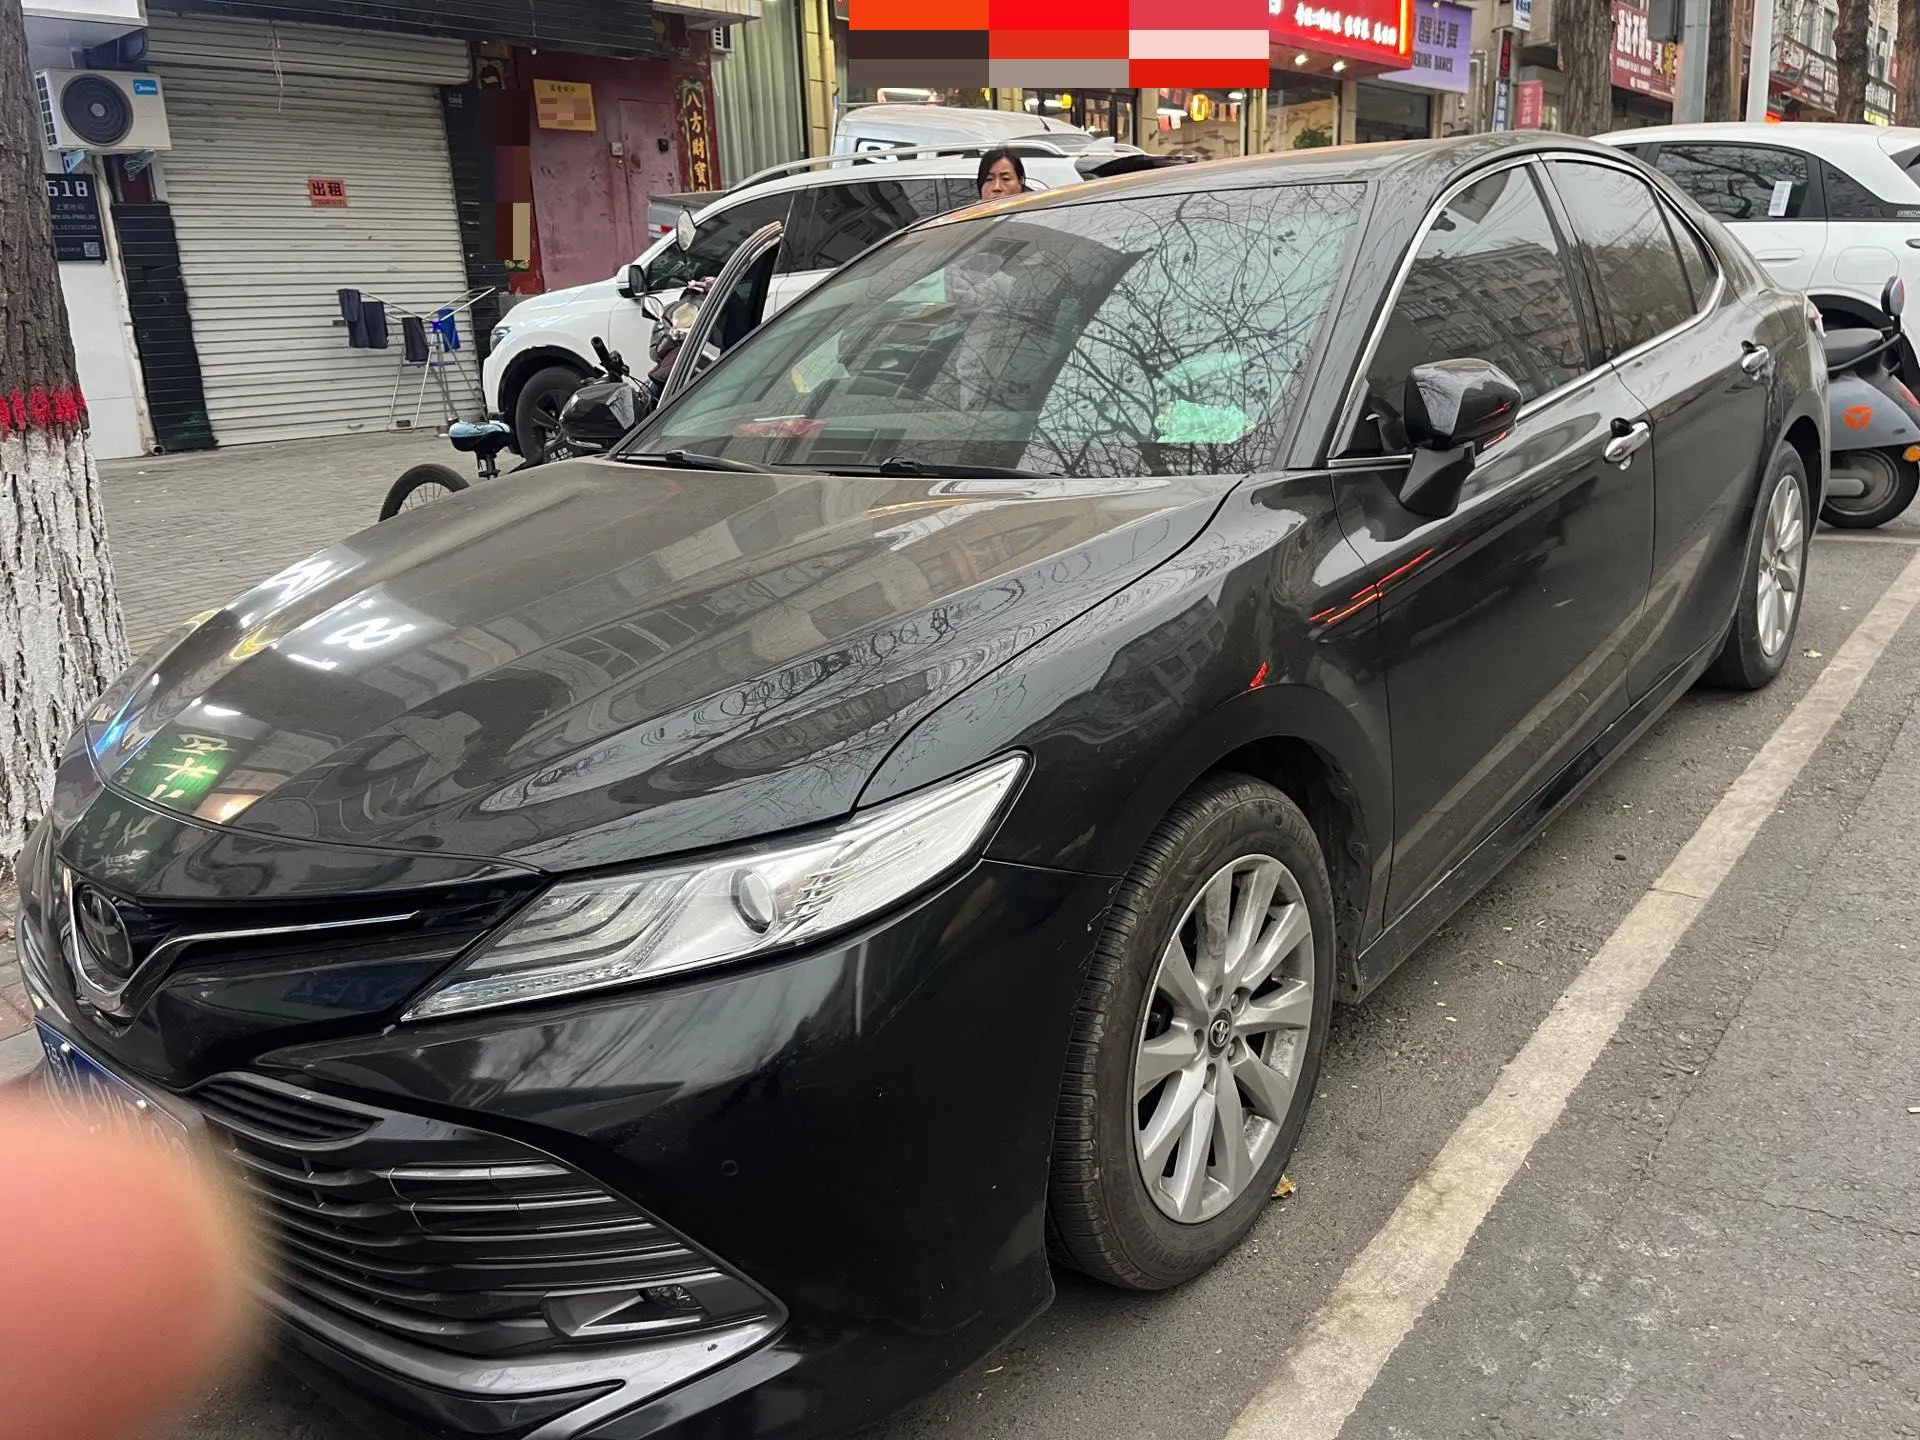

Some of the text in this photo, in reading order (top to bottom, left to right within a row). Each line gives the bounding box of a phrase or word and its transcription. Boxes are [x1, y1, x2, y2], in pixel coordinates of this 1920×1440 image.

[1413, 14, 1459, 49] 醒街舞
[312, 181, 343, 196] 出租
